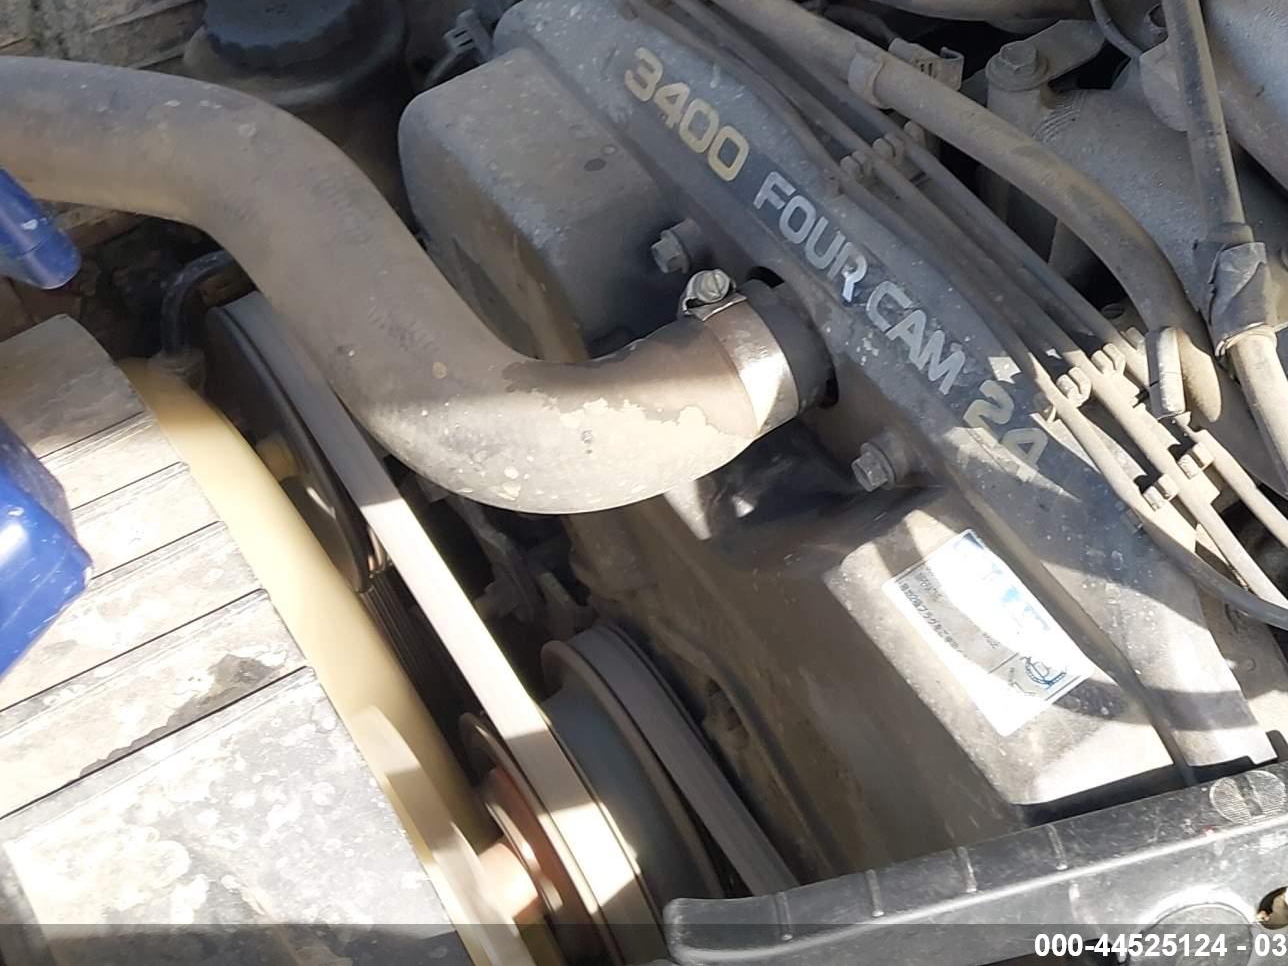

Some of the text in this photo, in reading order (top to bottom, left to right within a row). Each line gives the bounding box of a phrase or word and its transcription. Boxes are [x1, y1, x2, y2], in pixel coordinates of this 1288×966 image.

[624, 47, 1049, 483] 3400 FOUR CAM 24
